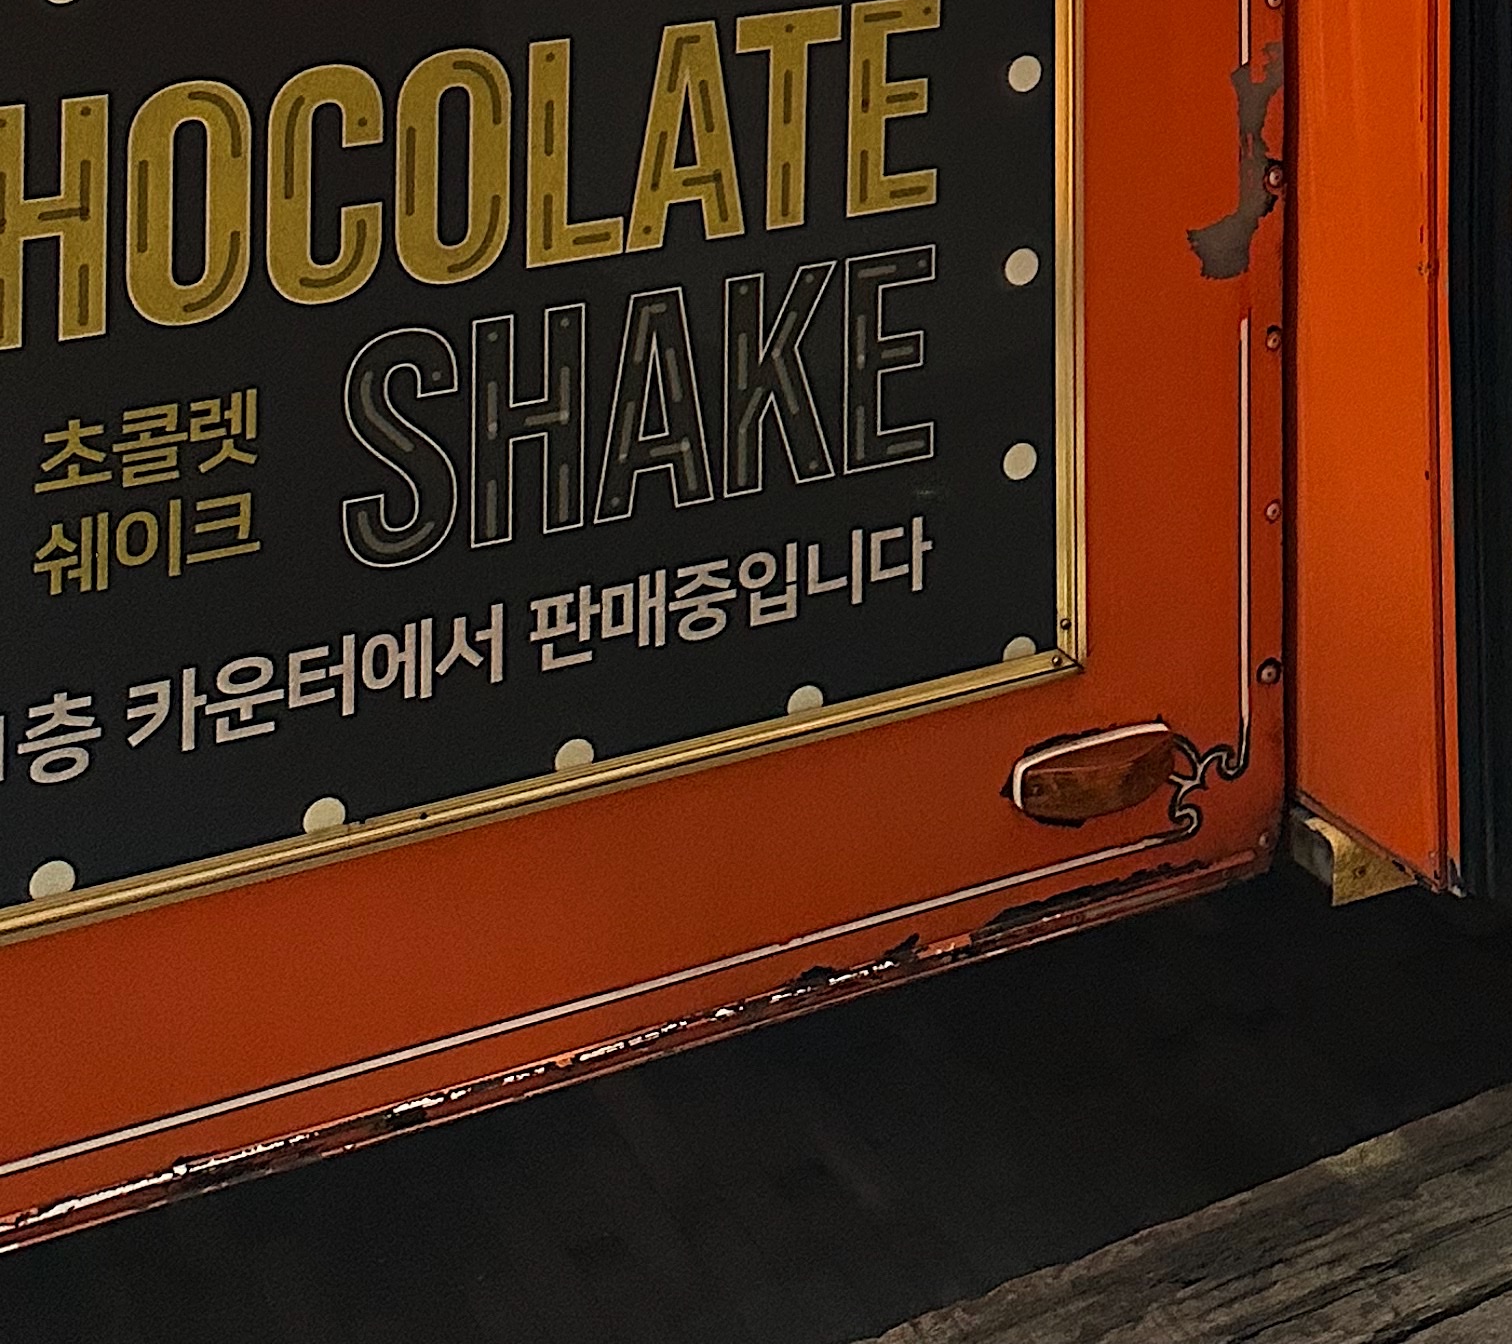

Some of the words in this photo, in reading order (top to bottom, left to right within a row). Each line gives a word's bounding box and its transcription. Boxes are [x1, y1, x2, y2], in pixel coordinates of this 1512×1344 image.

[33, 387, 261, 497] 초콜렛
[341, 243, 937, 569] SHAKE
[32, 492, 261, 597] 쉐이크
[126, 600, 505, 754] 카운터에서
[528, 515, 936, 675] 판매중입니다
